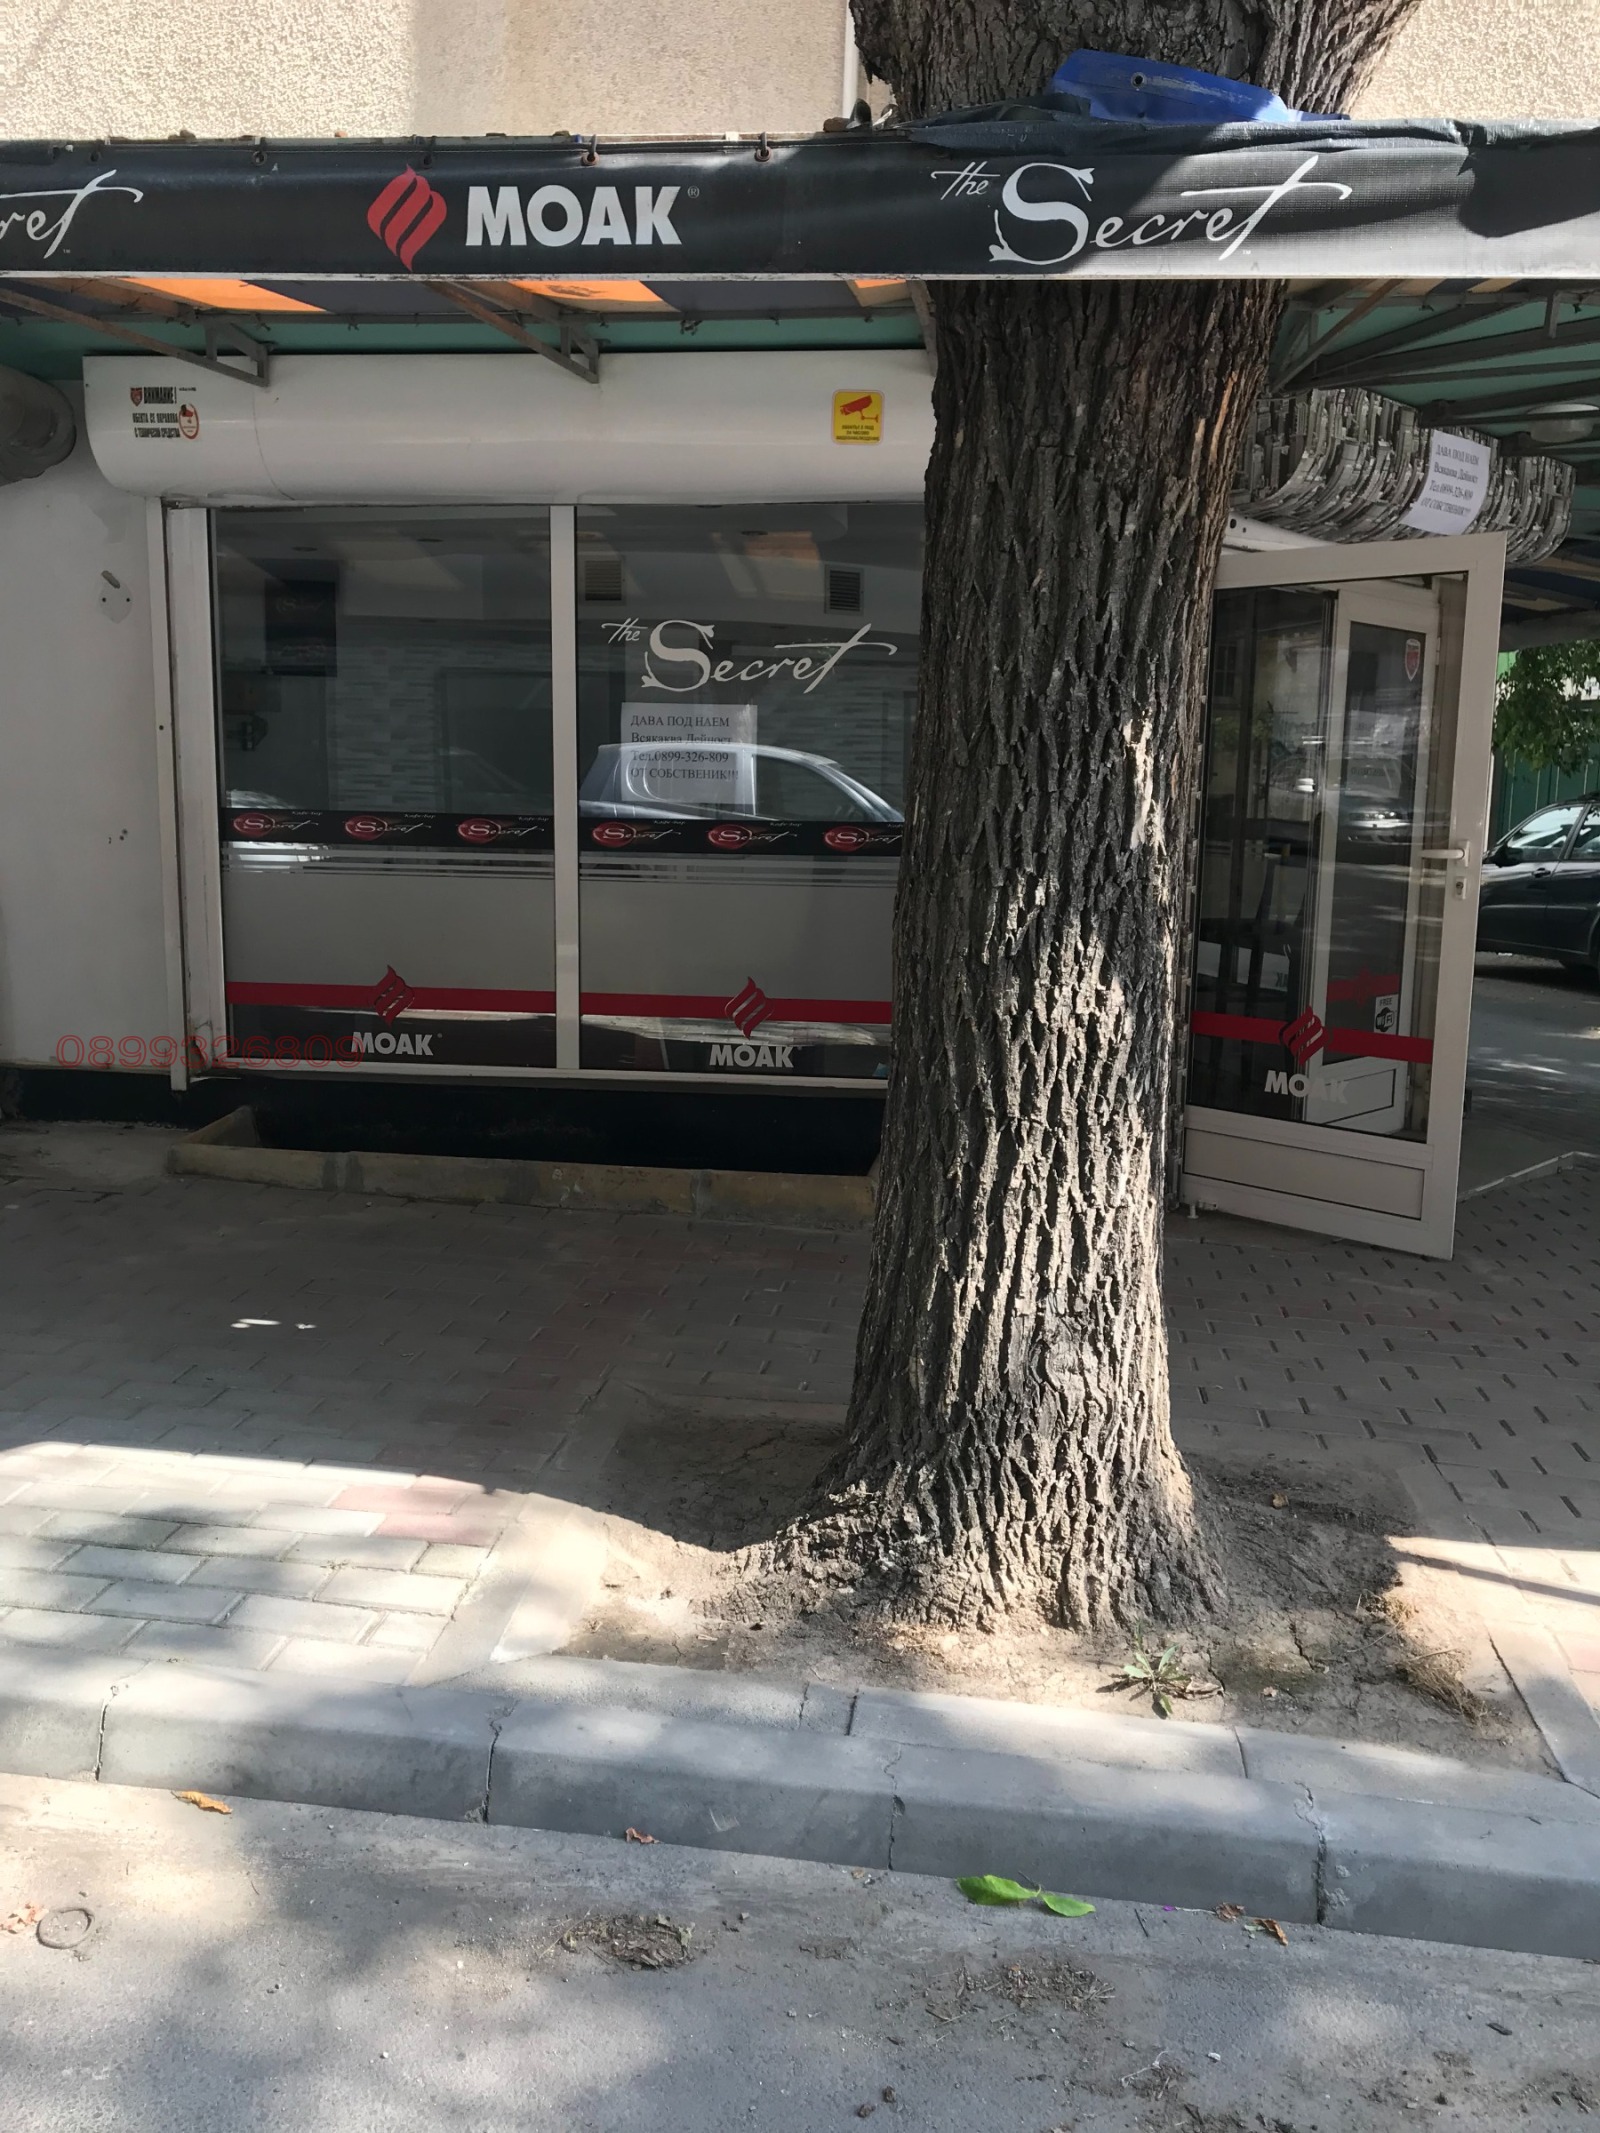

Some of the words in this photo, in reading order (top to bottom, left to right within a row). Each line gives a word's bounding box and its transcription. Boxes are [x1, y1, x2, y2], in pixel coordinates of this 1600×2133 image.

[465, 184, 683, 247] MOAK
[930, 161, 1001, 200] the
[988, 154, 1352, 266] Secret
[601, 617, 648, 644] the
[640, 619, 898, 694] Secret
[630, 715, 664, 727] ДАВА
[666, 716, 693, 728] ПОД
[695, 716, 730, 727] НАЕМ
[351, 1031, 434, 1056] MOAK
[709, 1044, 794, 1068] MOAK
[1264, 1069, 1349, 1104] MOAK
